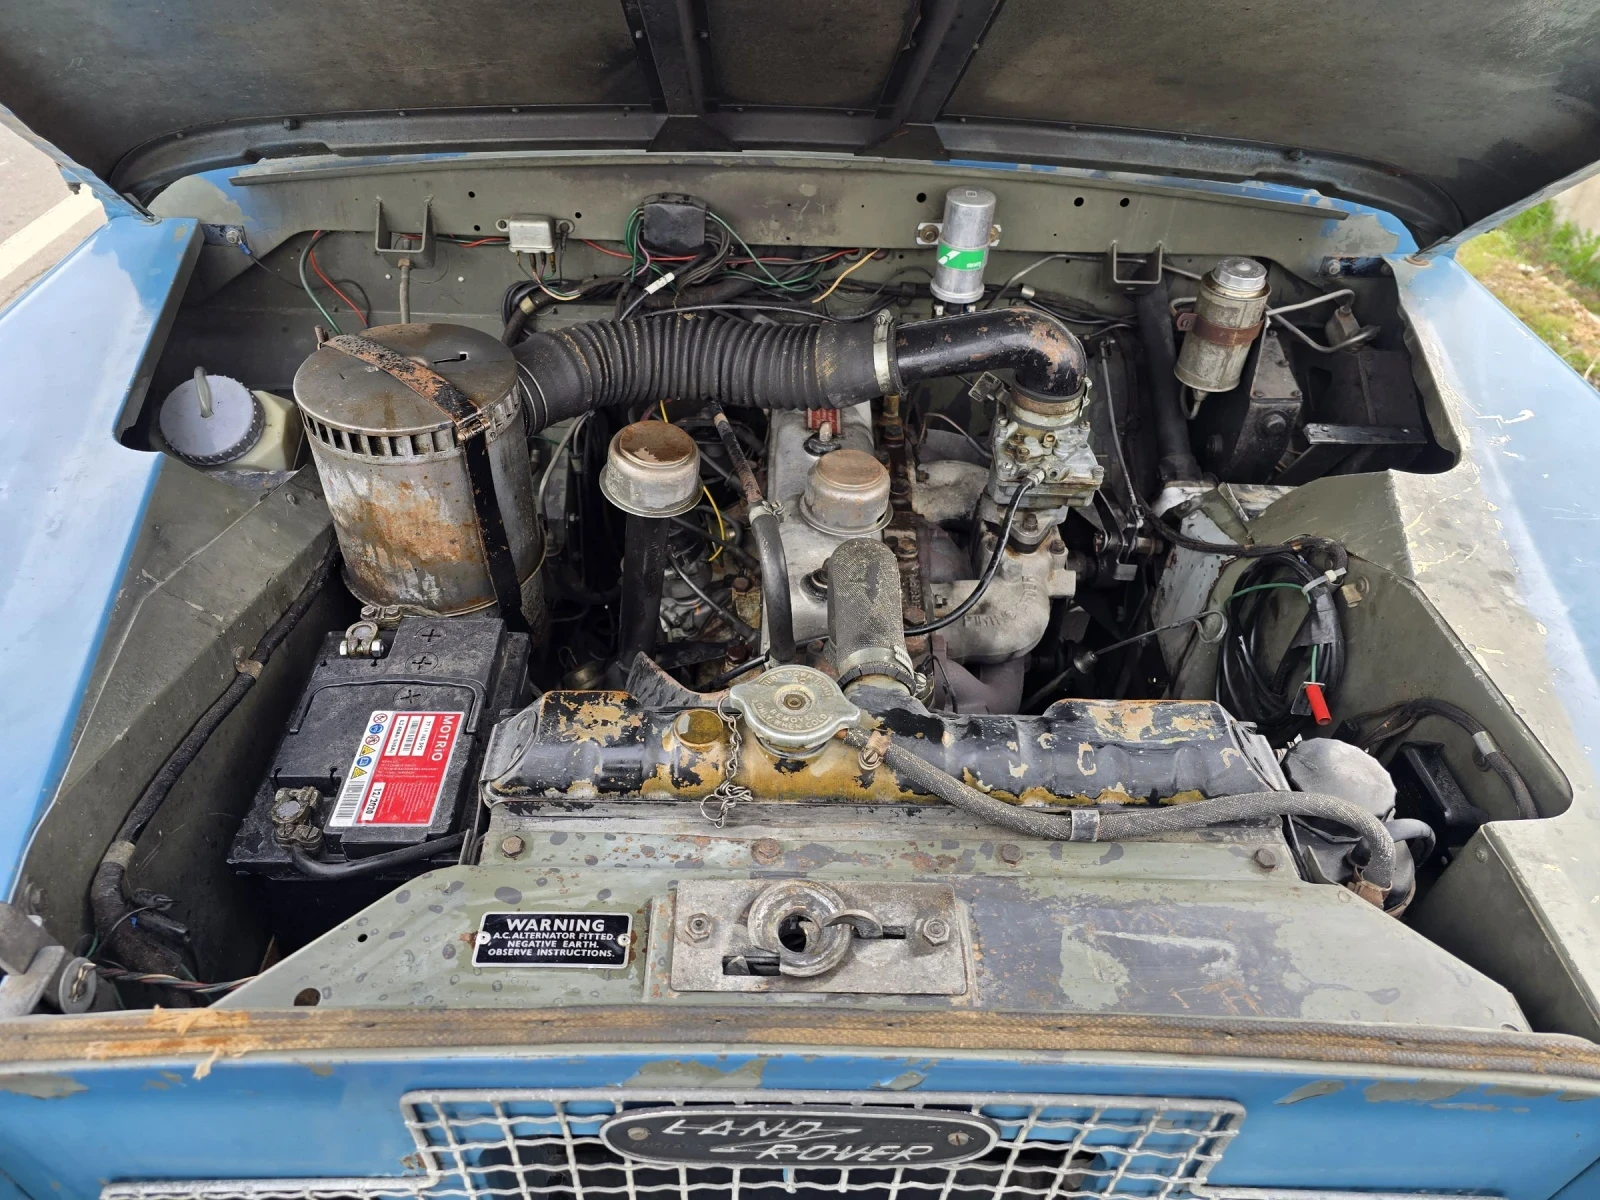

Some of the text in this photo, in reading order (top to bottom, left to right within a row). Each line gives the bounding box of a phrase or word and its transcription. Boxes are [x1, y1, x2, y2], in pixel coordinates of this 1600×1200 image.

[761, 670, 832, 697] TURN DOWN TIGHT
[757, 702, 828, 730] ONLY WHEN COLD
[770, 708, 812, 723] REMOVE
[365, 788, 382, 815] 12/2020
[506, 918, 605, 932] WARNING
[493, 932, 616, 941] A.C. ALTERNATOR FITTED.
[507, 940, 600, 949] NEGATIVE EARTH.
[488, 948, 615, 958] OBSERVE INSTRUCTIONS.
[662, 1119, 822, 1138] LAND
[755, 1143, 934, 1162] ROVER
